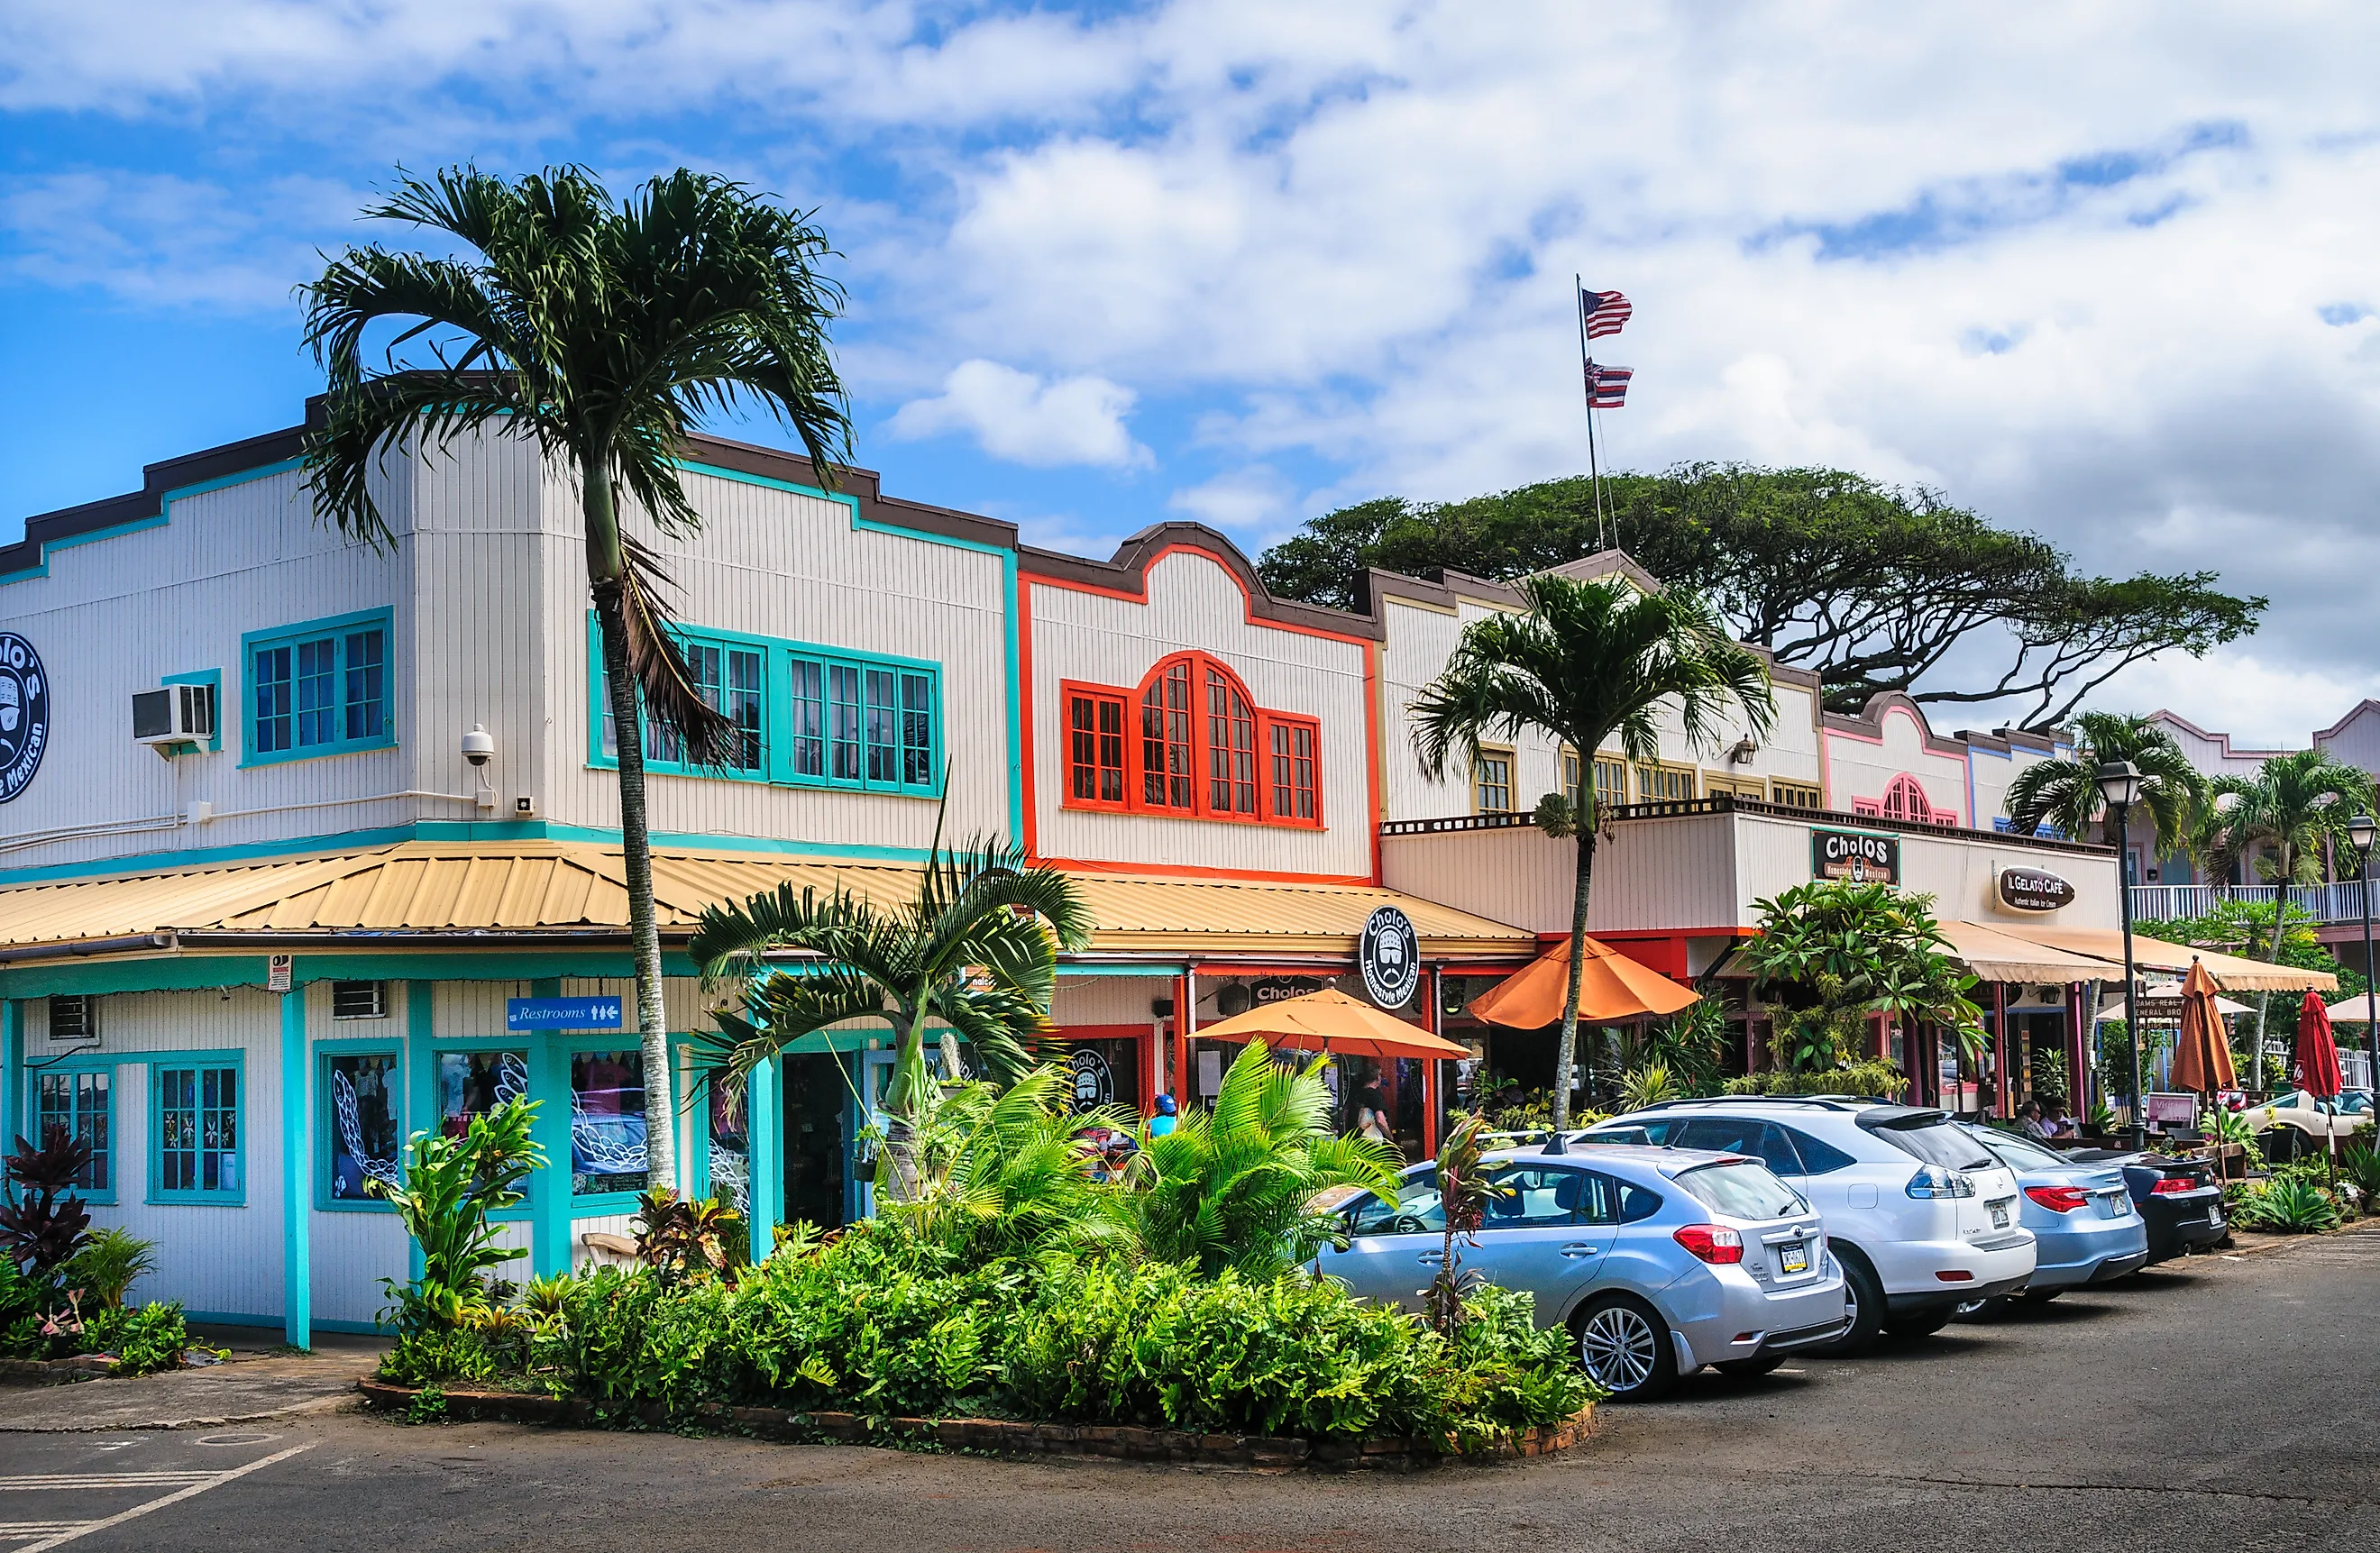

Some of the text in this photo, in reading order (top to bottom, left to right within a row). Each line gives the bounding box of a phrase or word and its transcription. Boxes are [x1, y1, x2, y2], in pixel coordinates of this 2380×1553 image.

[6, 722, 43, 793] Mexican
[1826, 835, 1888, 863] Cholos
[1368, 909, 1412, 939] Cholo's
[1365, 959, 1416, 1004] Homestyle Mexican
[518, 1007, 586, 1021] Restrooms
[2159, 999, 2177, 1007] REAL
